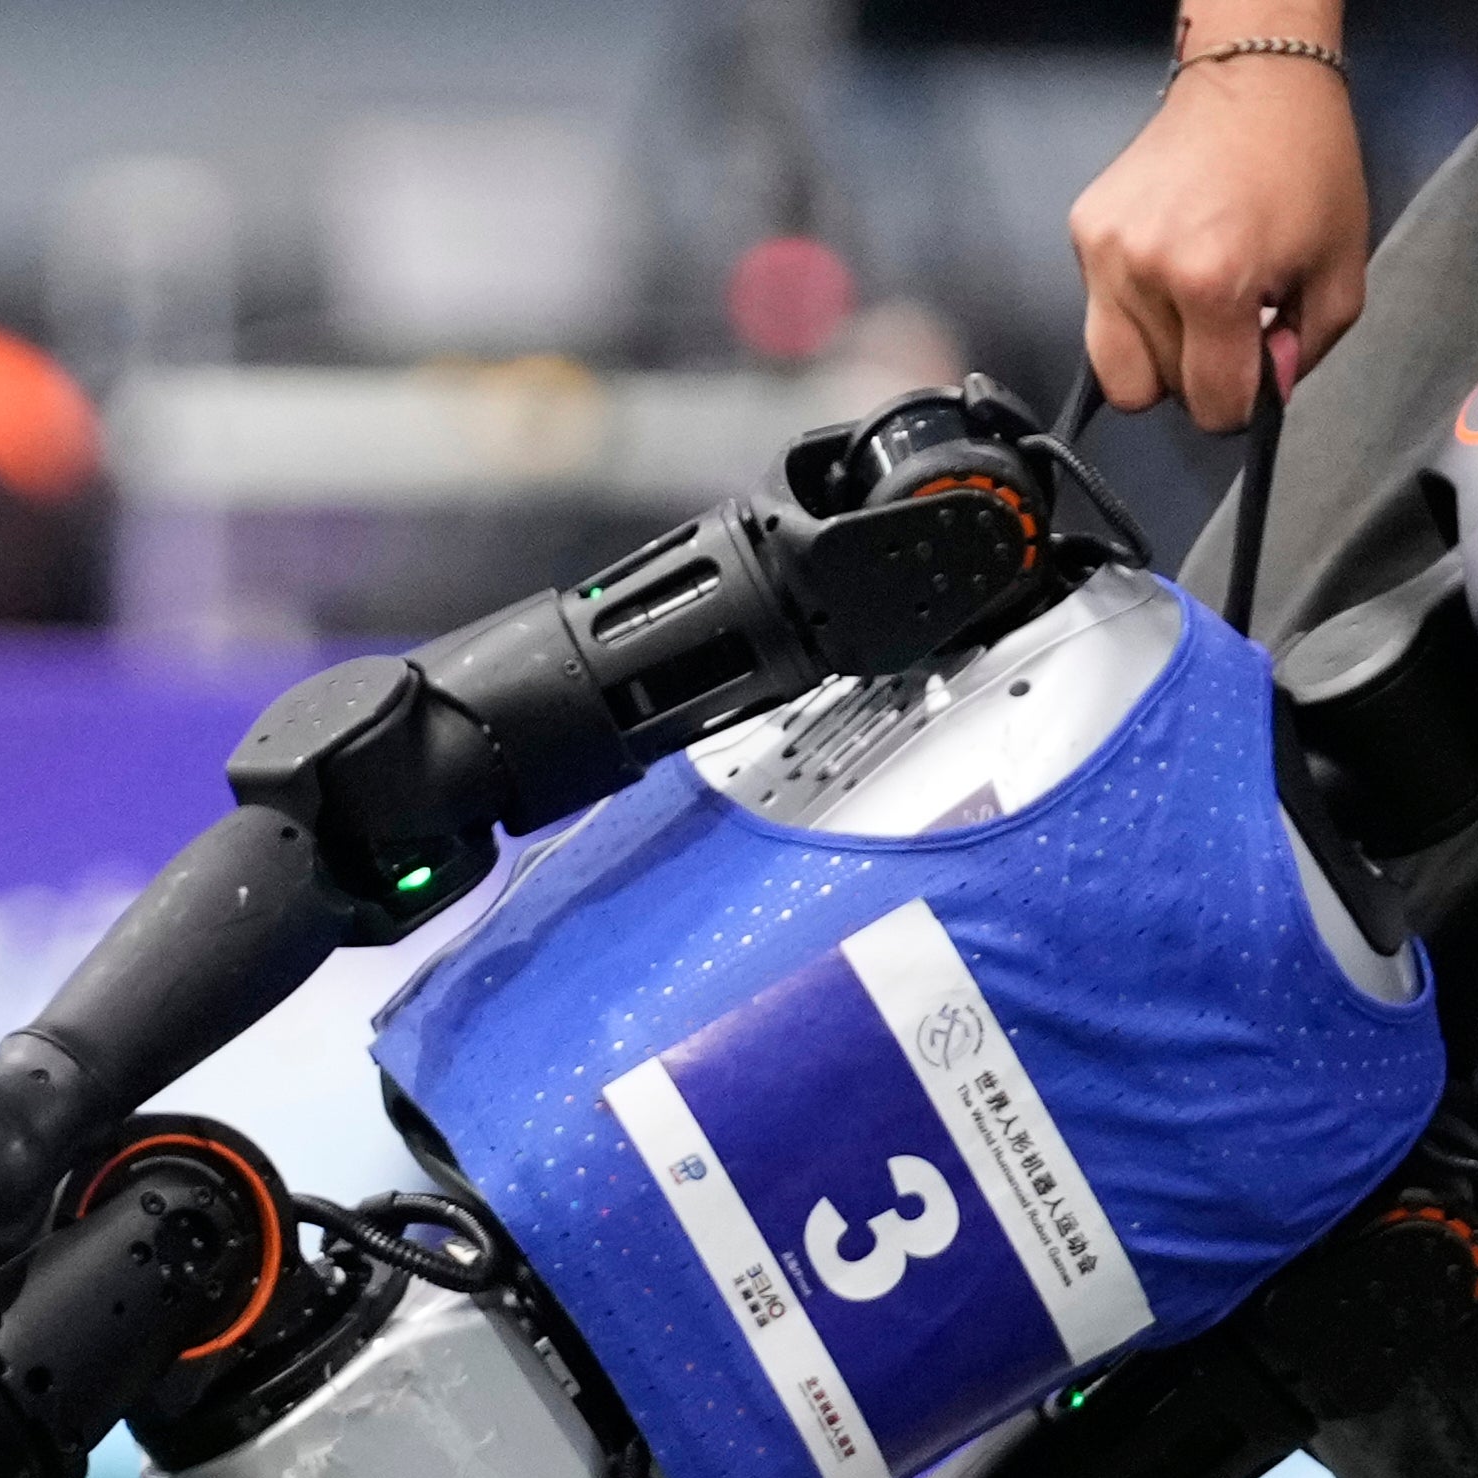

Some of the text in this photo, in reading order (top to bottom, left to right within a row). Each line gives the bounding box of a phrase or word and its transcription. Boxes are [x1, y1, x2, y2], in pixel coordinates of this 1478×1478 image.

[805, 1155, 959, 1301] 3
[974, 1069, 1099, 1275] 世界人形机器人运动会
